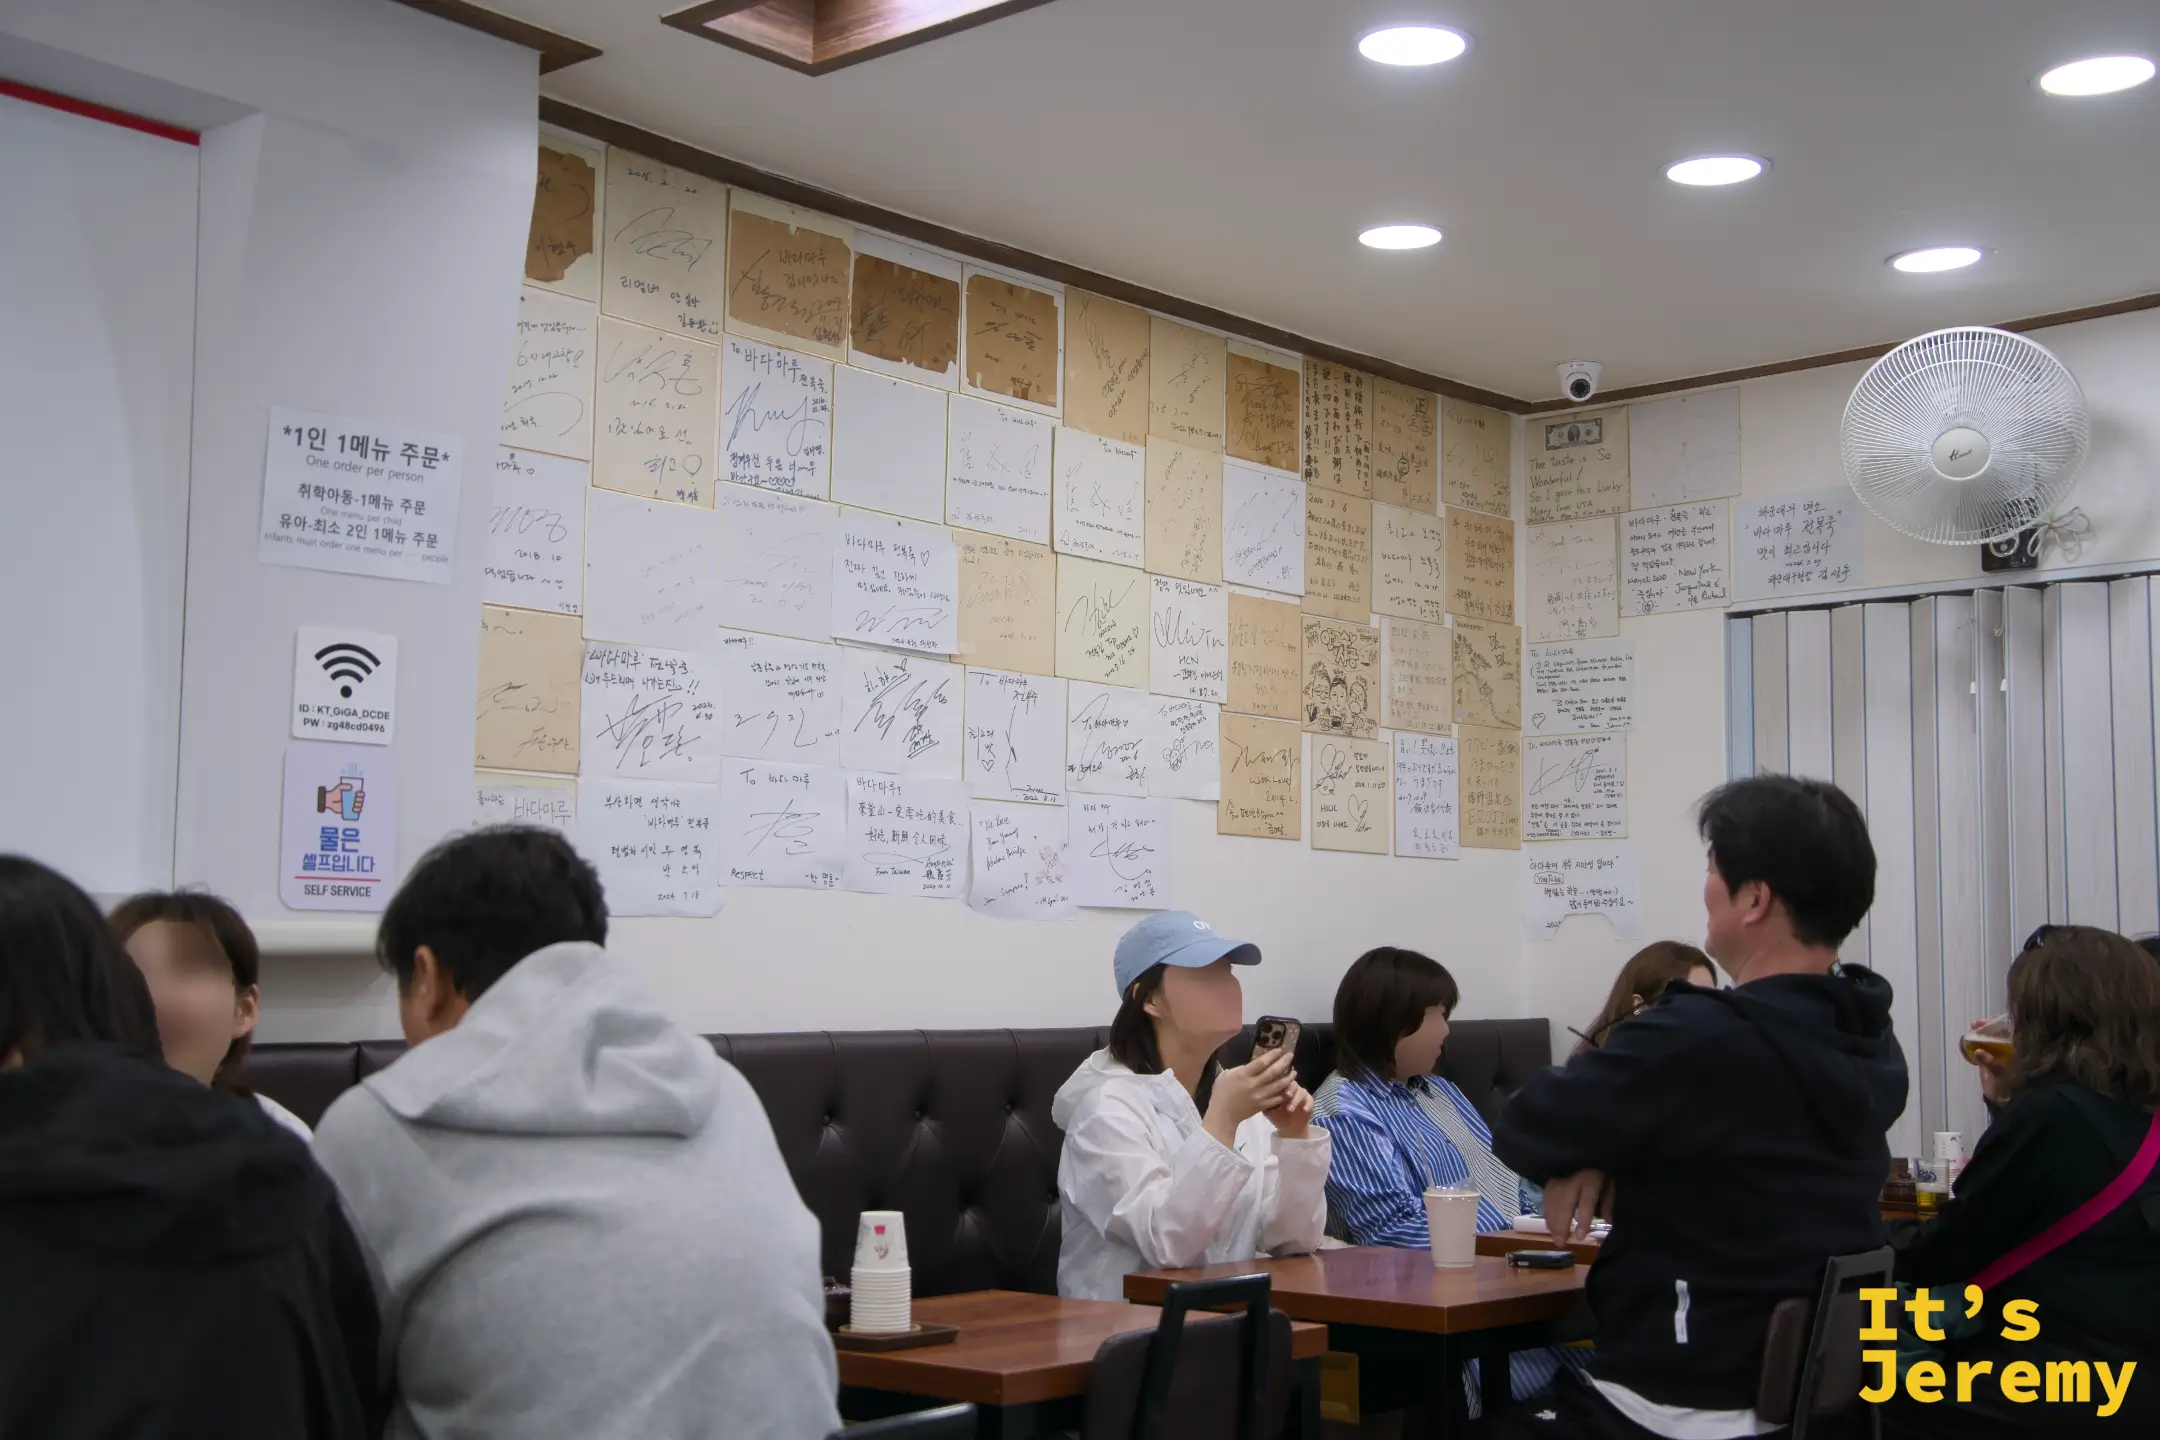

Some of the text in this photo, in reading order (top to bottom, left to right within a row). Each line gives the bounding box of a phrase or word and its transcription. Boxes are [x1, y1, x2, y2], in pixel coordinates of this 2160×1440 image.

[745, 348, 802, 383] 바다마루
[337, 434, 390, 463] 1메뉴
[306, 455, 424, 484] One order per person
[1528, 459, 1546, 472] The
[1597, 448, 1611, 460] So
[298, 483, 426, 516] 취학아동-1메뉴 주문
[1529, 491, 1540, 502] So
[1598, 480, 1622, 492] Lucky
[320, 506, 402, 526] One menu per child
[1758, 501, 1826, 519] 해운대의 명소
[279, 513, 438, 549] 유아-최소 2인 1메뉴 주문
[1628, 515, 1661, 527] 바다마루
[1753, 523, 1793, 538] 바다마루
[320, 539, 342, 550] order
[845, 533, 885, 556] 바다마루
[299, 703, 309, 713] ID
[303, 718, 320, 727] PW
[514, 797, 571, 826] 바다마루
[320, 826, 360, 853] 물은
[302, 853, 376, 873] 셀프입니다
[731, 868, 764, 880] Respect
[1537, 875, 1561, 883] YouTube
[304, 884, 372, 897] SELF SERVICE
